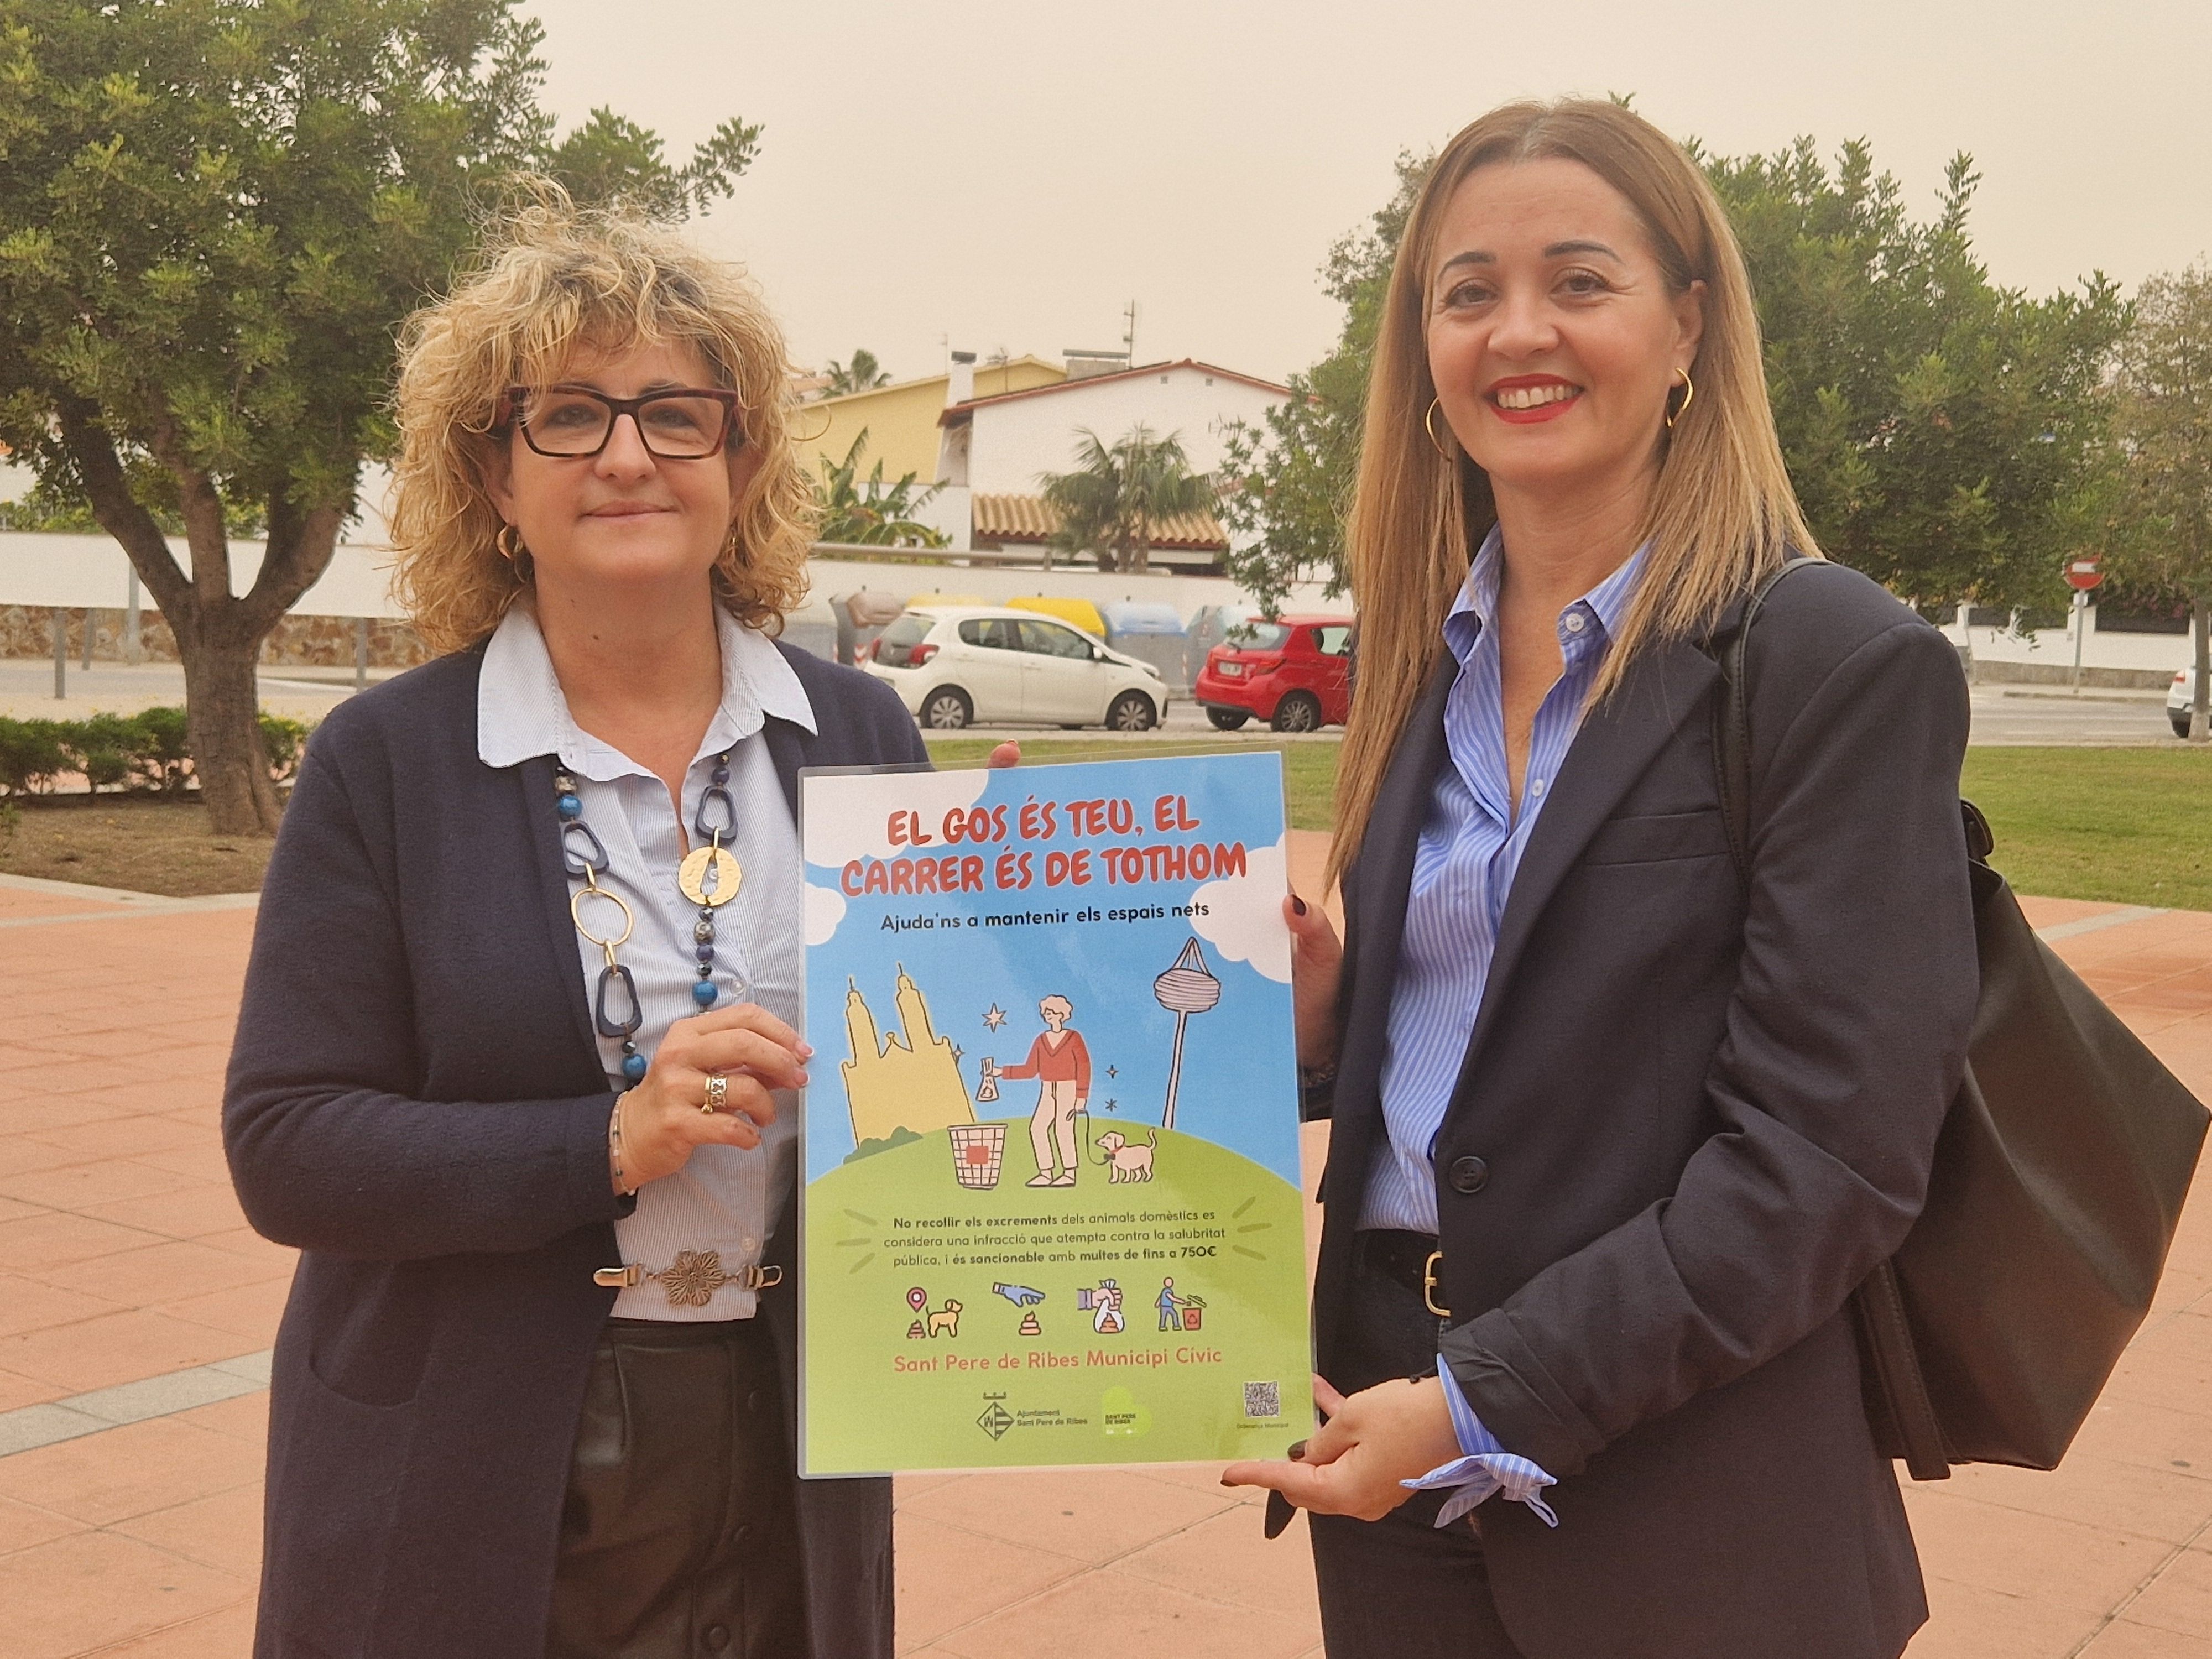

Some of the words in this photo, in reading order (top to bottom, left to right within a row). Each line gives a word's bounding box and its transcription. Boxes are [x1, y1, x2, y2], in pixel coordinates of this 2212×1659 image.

[888, 810, 932, 846] EL
[943, 805, 1007, 844] GOS
[1020, 795, 1056, 839] ÉS
[1065, 799, 1143, 837] TEU,
[1155, 795, 1199, 831] EL
[841, 855, 983, 896] CARRER
[996, 845, 1032, 890] ÉS
[1046, 849, 1092, 886] DE
[1100, 842, 1246, 885] TOTHOM
[881, 912, 961, 933] Ajuda'ns
[967, 916, 978, 927] a
[985, 909, 1069, 926] mantenir
[1077, 906, 1100, 921] els
[1108, 904, 1164, 923] espais
[1172, 902, 1209, 917] nets
[894, 1218, 911, 1228] No
[916, 1217, 960, 1228] recollir
[965, 1217, 982, 1227] els
[987, 1215, 1057, 1226] excrements
[1062, 1213, 1084, 1224] dels
[1089, 1212, 1135, 1223] animals
[1139, 1211, 1198, 1222] domèstics
[1203, 1212, 1214, 1220] es
[884, 1236, 942, 1247] considera
[974, 1233, 1026, 1244] infracció
[1031, 1236, 1052, 1245] que
[1057, 1230, 1106, 1244] atempta
[1110, 1230, 1150, 1241] contra
[1154, 1229, 1164, 1239] la
[1169, 1228, 1225, 1239] salubritat
[894, 1255, 940, 1267] pública,
[945, 1254, 948, 1265] i
[953, 1254, 966, 1264] és
[970, 1252, 1044, 1263] sancionable
[1048, 1251, 1075, 1262] amb
[1080, 1250, 1119, 1261] multes
[1124, 1249, 1138, 1260] de
[1143, 1248, 1165, 1259] fins
[1181, 1246, 1217, 1258] 750€
[894, 1355, 938, 1372] Sant
[946, 1354, 990, 1370] Pere
[998, 1353, 1020, 1369] de
[1028, 1351, 1078, 1367] Ribes
[1087, 1349, 1168, 1368] Municipi
[1176, 1347, 1222, 1363] Cívic
